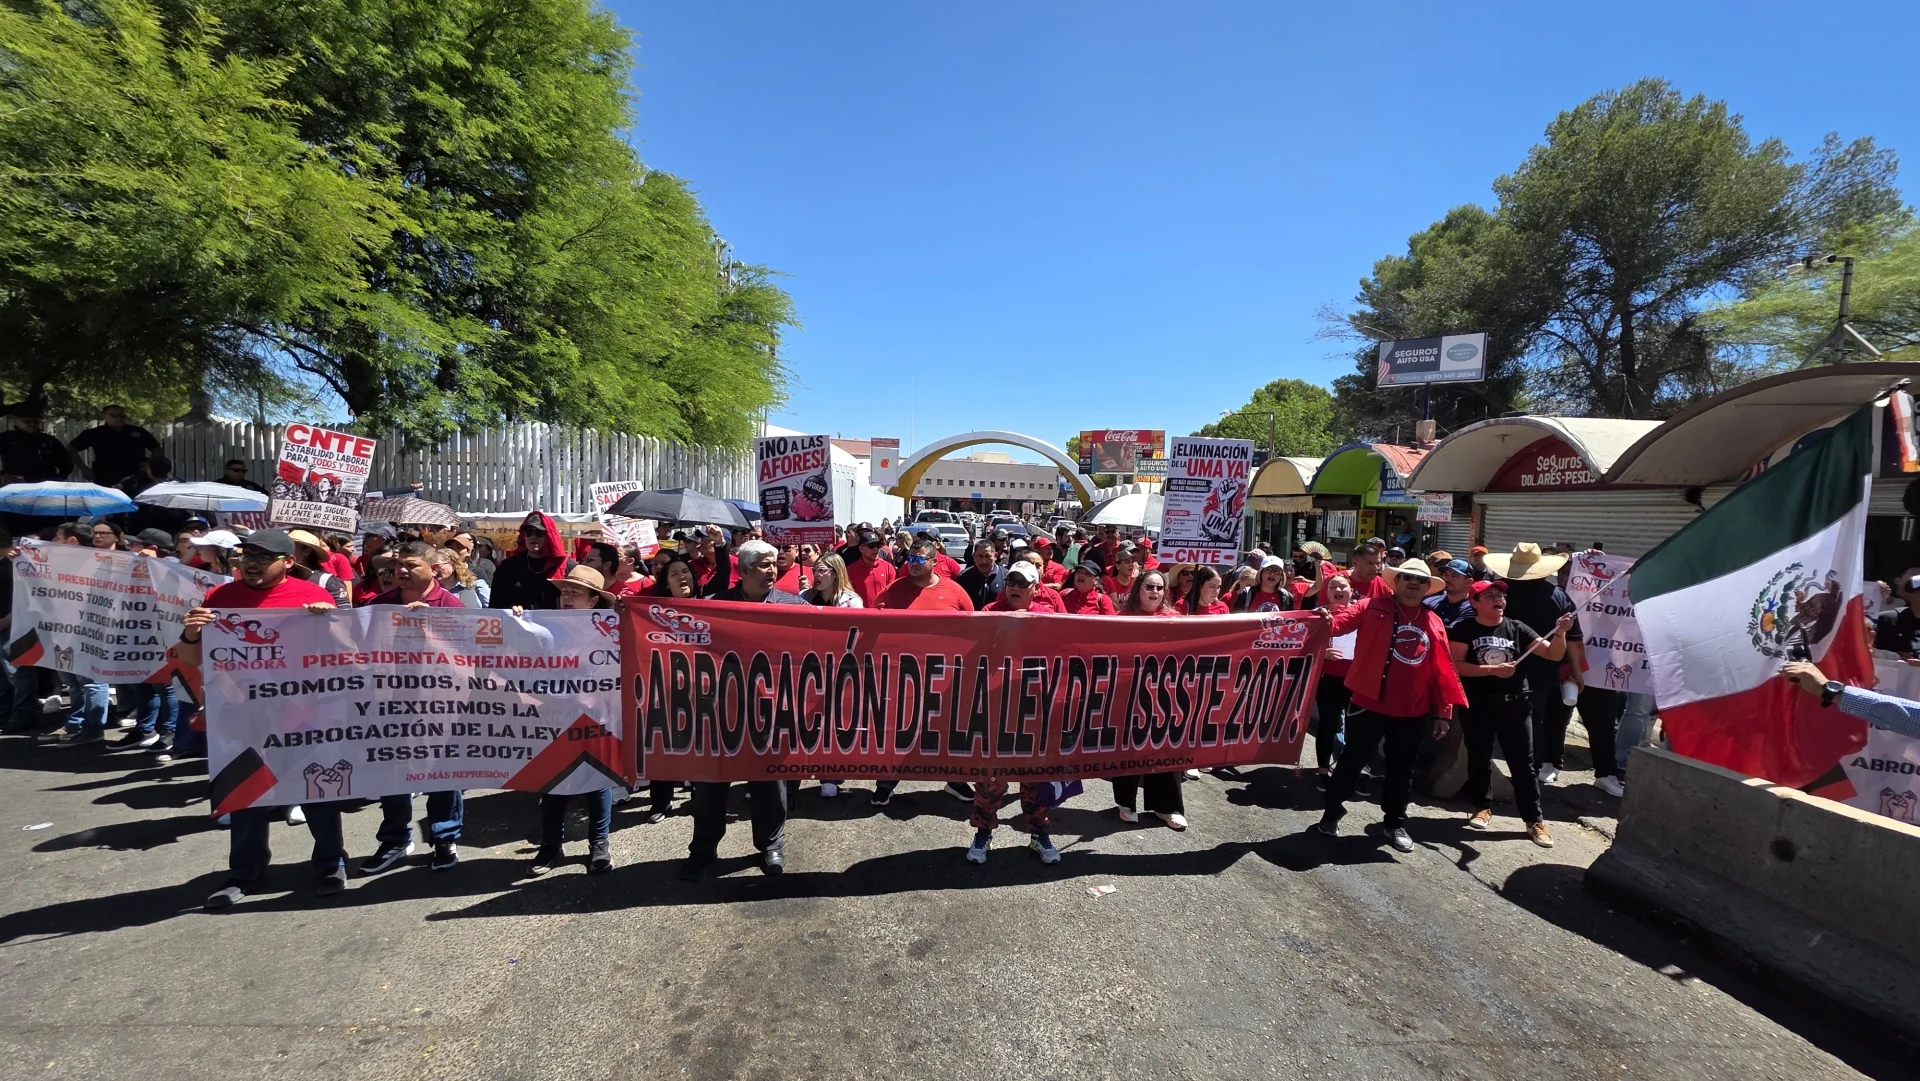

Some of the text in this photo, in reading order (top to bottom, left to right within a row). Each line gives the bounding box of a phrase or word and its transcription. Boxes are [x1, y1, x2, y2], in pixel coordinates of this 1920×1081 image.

[1394, 348, 1438, 358] SEGUROS
[1397, 355, 1435, 365] AUTO USA
[1424, 373, 1442, 381] (631)
[286, 424, 375, 459] CNTE
[760, 436, 824, 460] ¡NO A LAS
[284, 443, 369, 467] ESTABILIDAD LABORAL
[1173, 443, 1249, 459] ¡ELIMINACIÓN
[286, 452, 309, 464] PARA
[312, 457, 337, 469] TODOS
[345, 465, 368, 475] TODAS
[760, 448, 826, 482] AFORES!
[1171, 458, 1250, 479] DE LA UMA YA!
[1536, 454, 1583, 473] Seguros
[594, 482, 638, 495] ¡AUMENTO
[805, 480, 826, 494] AFORES
[1387, 479, 1400, 489] USA
[292, 509, 312, 518] CNTE
[313, 511, 322, 519] NO
[300, 502, 322, 512] LUCHA
[324, 504, 349, 515] SIGUE!
[1206, 514, 1233, 535] UMA
[765, 534, 801, 544] CNTE
[1175, 549, 1221, 563] CNTE
[16, 561, 51, 574] CNTE
[16, 570, 52, 580] SONORA
[132, 560, 149, 573] 28
[57, 573, 117, 592] PRESIDENTA
[31, 587, 84, 602] ¡SOMOS
[86, 593, 116, 611] TODOS,
[121, 601, 147, 612] NO
[78, 610, 153, 630] Y ¡EXIGIMOS
[391, 612, 426, 628] SNTE
[476, 618, 502, 636] 28
[37, 620, 159, 646] ABROGACIÓN DE LA
[646, 632, 712, 645] CNTE
[209, 645, 285, 662] CNTE
[1252, 640, 1304, 650] Sonora
[213, 659, 287, 671] SONORA
[302, 651, 579, 669] PRESIDENTA SHEINBAUM
[588, 650, 621, 665] CN
[249, 674, 621, 700] ¡SOMOS TODOS, NO ALGUNOS!
[354, 700, 541, 719] Y ¡EXIGIMOS LA
[634, 626, 1314, 779] ¡ABROGACIÓN DE LA LEY DEL ISSSTE 2007!
[262, 719, 613, 749] ABROGACIÓN DE LA LEY DEL
[366, 745, 533, 763] ISSSTE 2007!
[766, 756, 1194, 777] COORDINADORA NACIONAL DE TRABADORES DE LA EDUCACIÓN
[405, 770, 510, 782] ¡NO MÁS REPRESIÓN!
